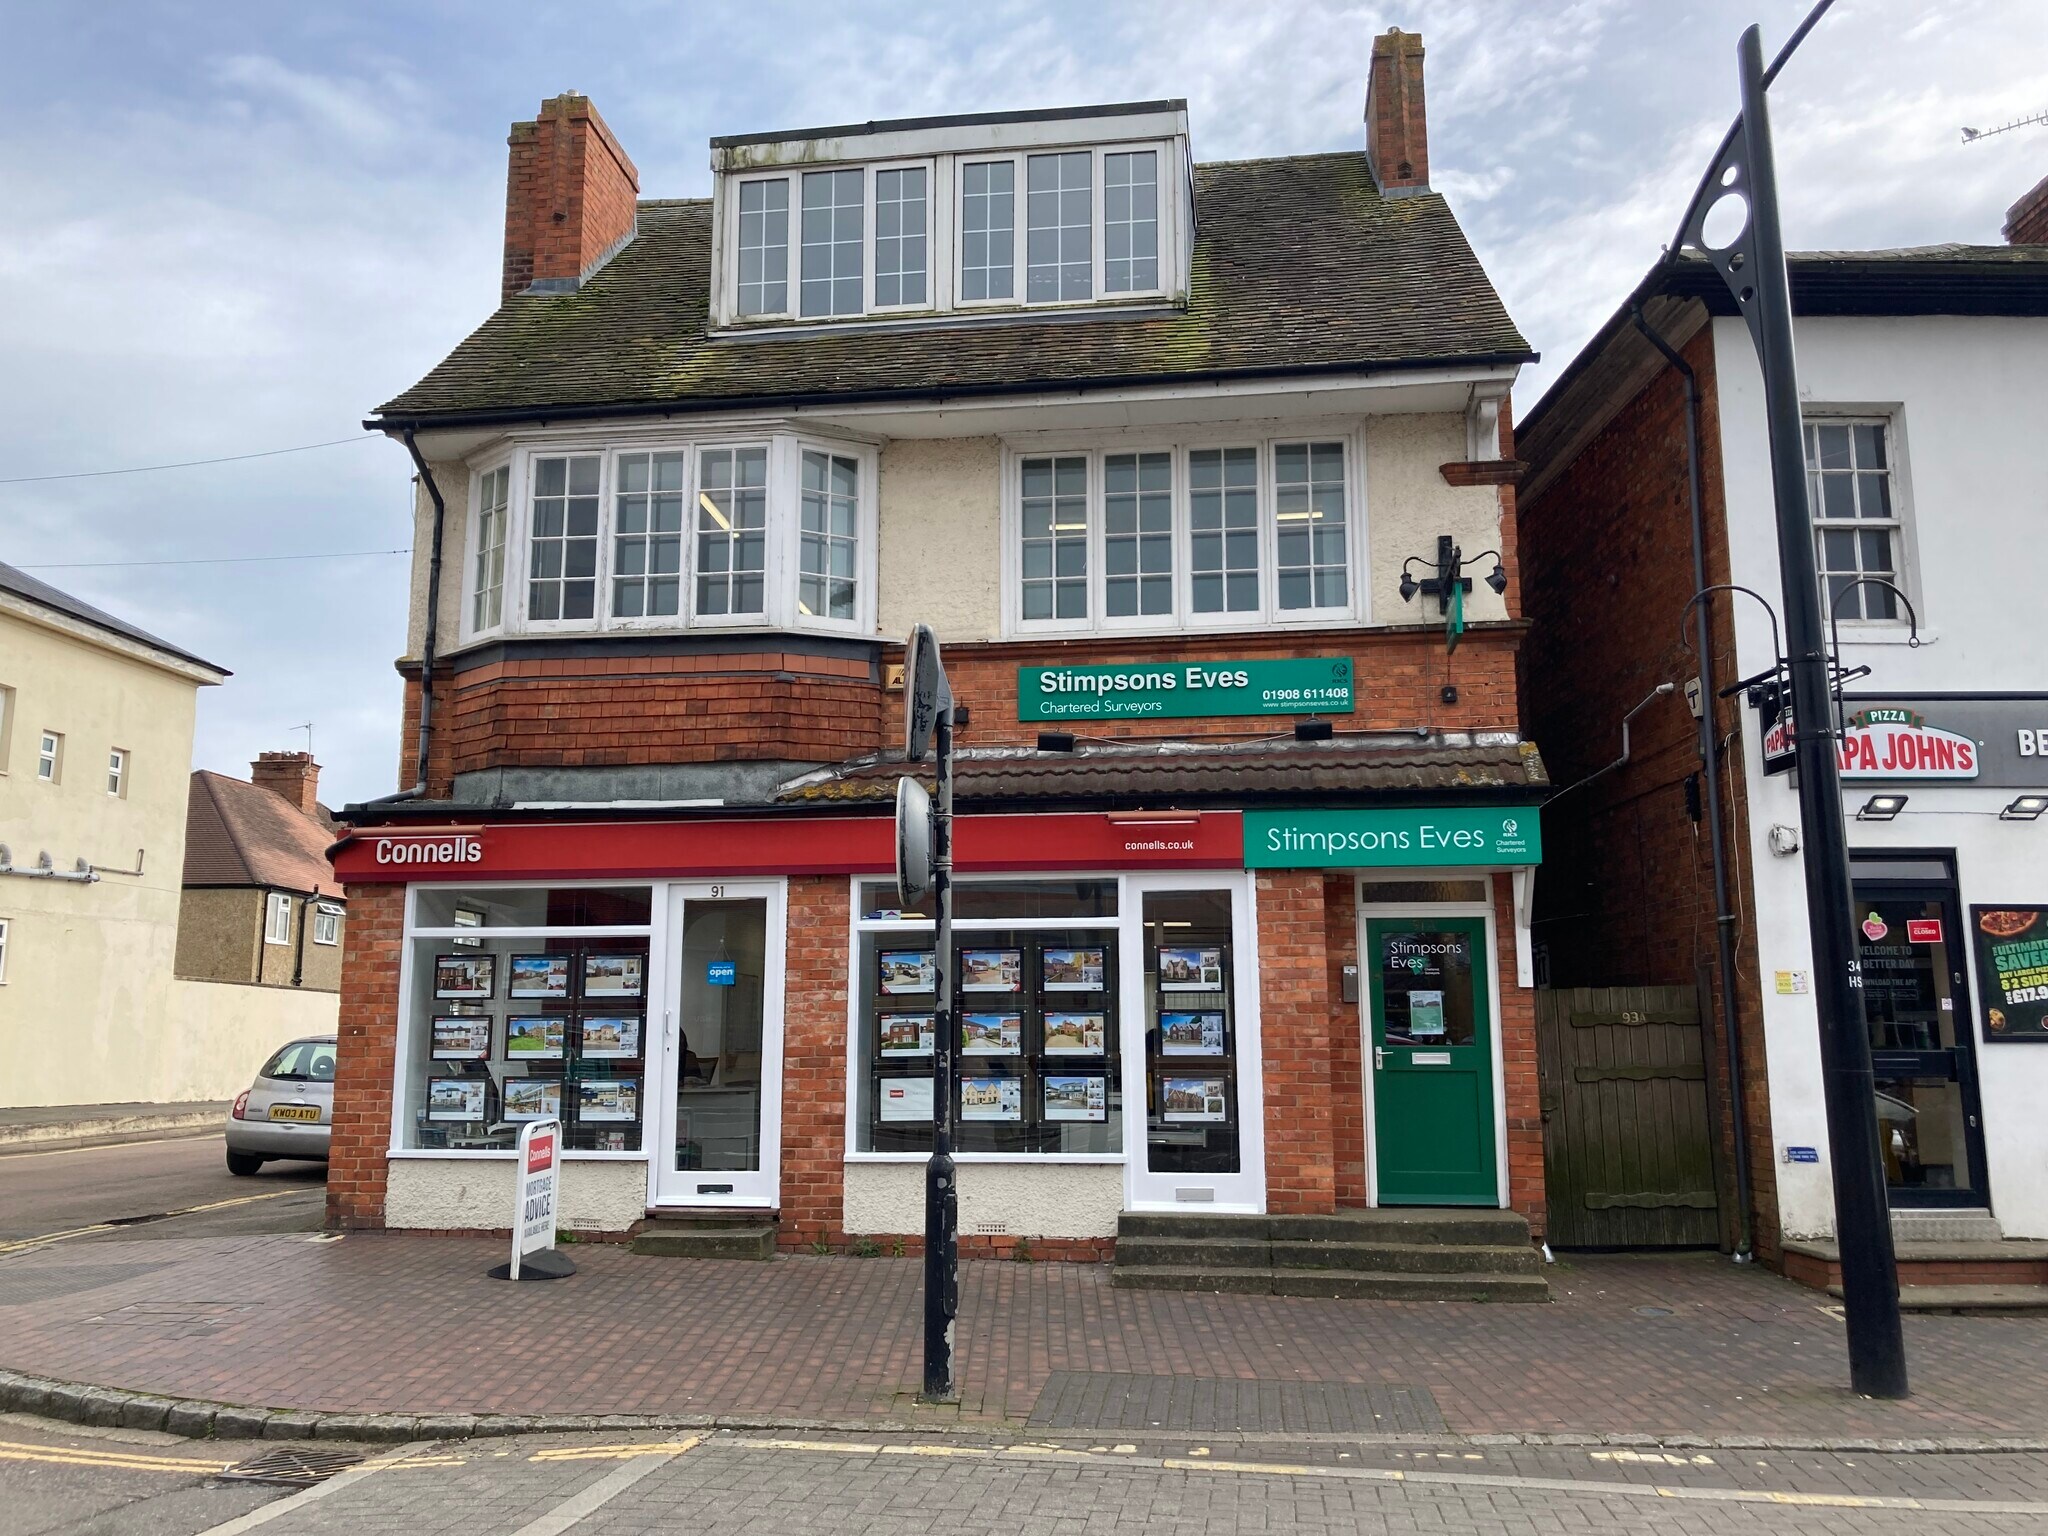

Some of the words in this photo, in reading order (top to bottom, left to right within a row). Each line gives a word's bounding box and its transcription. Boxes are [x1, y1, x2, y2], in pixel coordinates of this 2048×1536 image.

[1040, 670, 1176, 696] Stimpsons
[1186, 667, 1249, 689] Eves
[1262, 689, 1300, 700] 01908
[1303, 687, 1349, 699] 611408
[1040, 701, 1100, 714] Chartered
[1104, 700, 1162, 714] Surveyors
[1870, 710, 1906, 722] PIZZA
[1837, 734, 1879, 770] PA
[1882, 733, 1973, 770] JOHN'S
[1125, 839, 1194, 851] connells.co.uk
[1267, 827, 1410, 856] Stimpsons
[1419, 825, 1485, 849] Eves
[376, 838, 482, 864] Connells
[1496, 846, 1527, 854] Surveyors
[711, 885, 724, 898] 91
[1390, 942, 1462, 956] Stimpsons
[1900, 945, 1912, 955] TO
[1391, 956, 1423, 969] Eves
[1847, 960, 1861, 972] 34
[1863, 959, 1897, 969] BETTER
[1899, 959, 1915, 969] DAY
[709, 968, 733, 978] open
[1848, 976, 1863, 988] HS
[2011, 978, 2020, 989] 2
[1622, 1012, 1646, 1024] 93A
[297, 1110, 317, 1119] ATU
[529, 1145, 551, 1162] Connells
[526, 1176, 552, 1198] MORTGAGE
[524, 1193, 552, 1224] ADVICE
